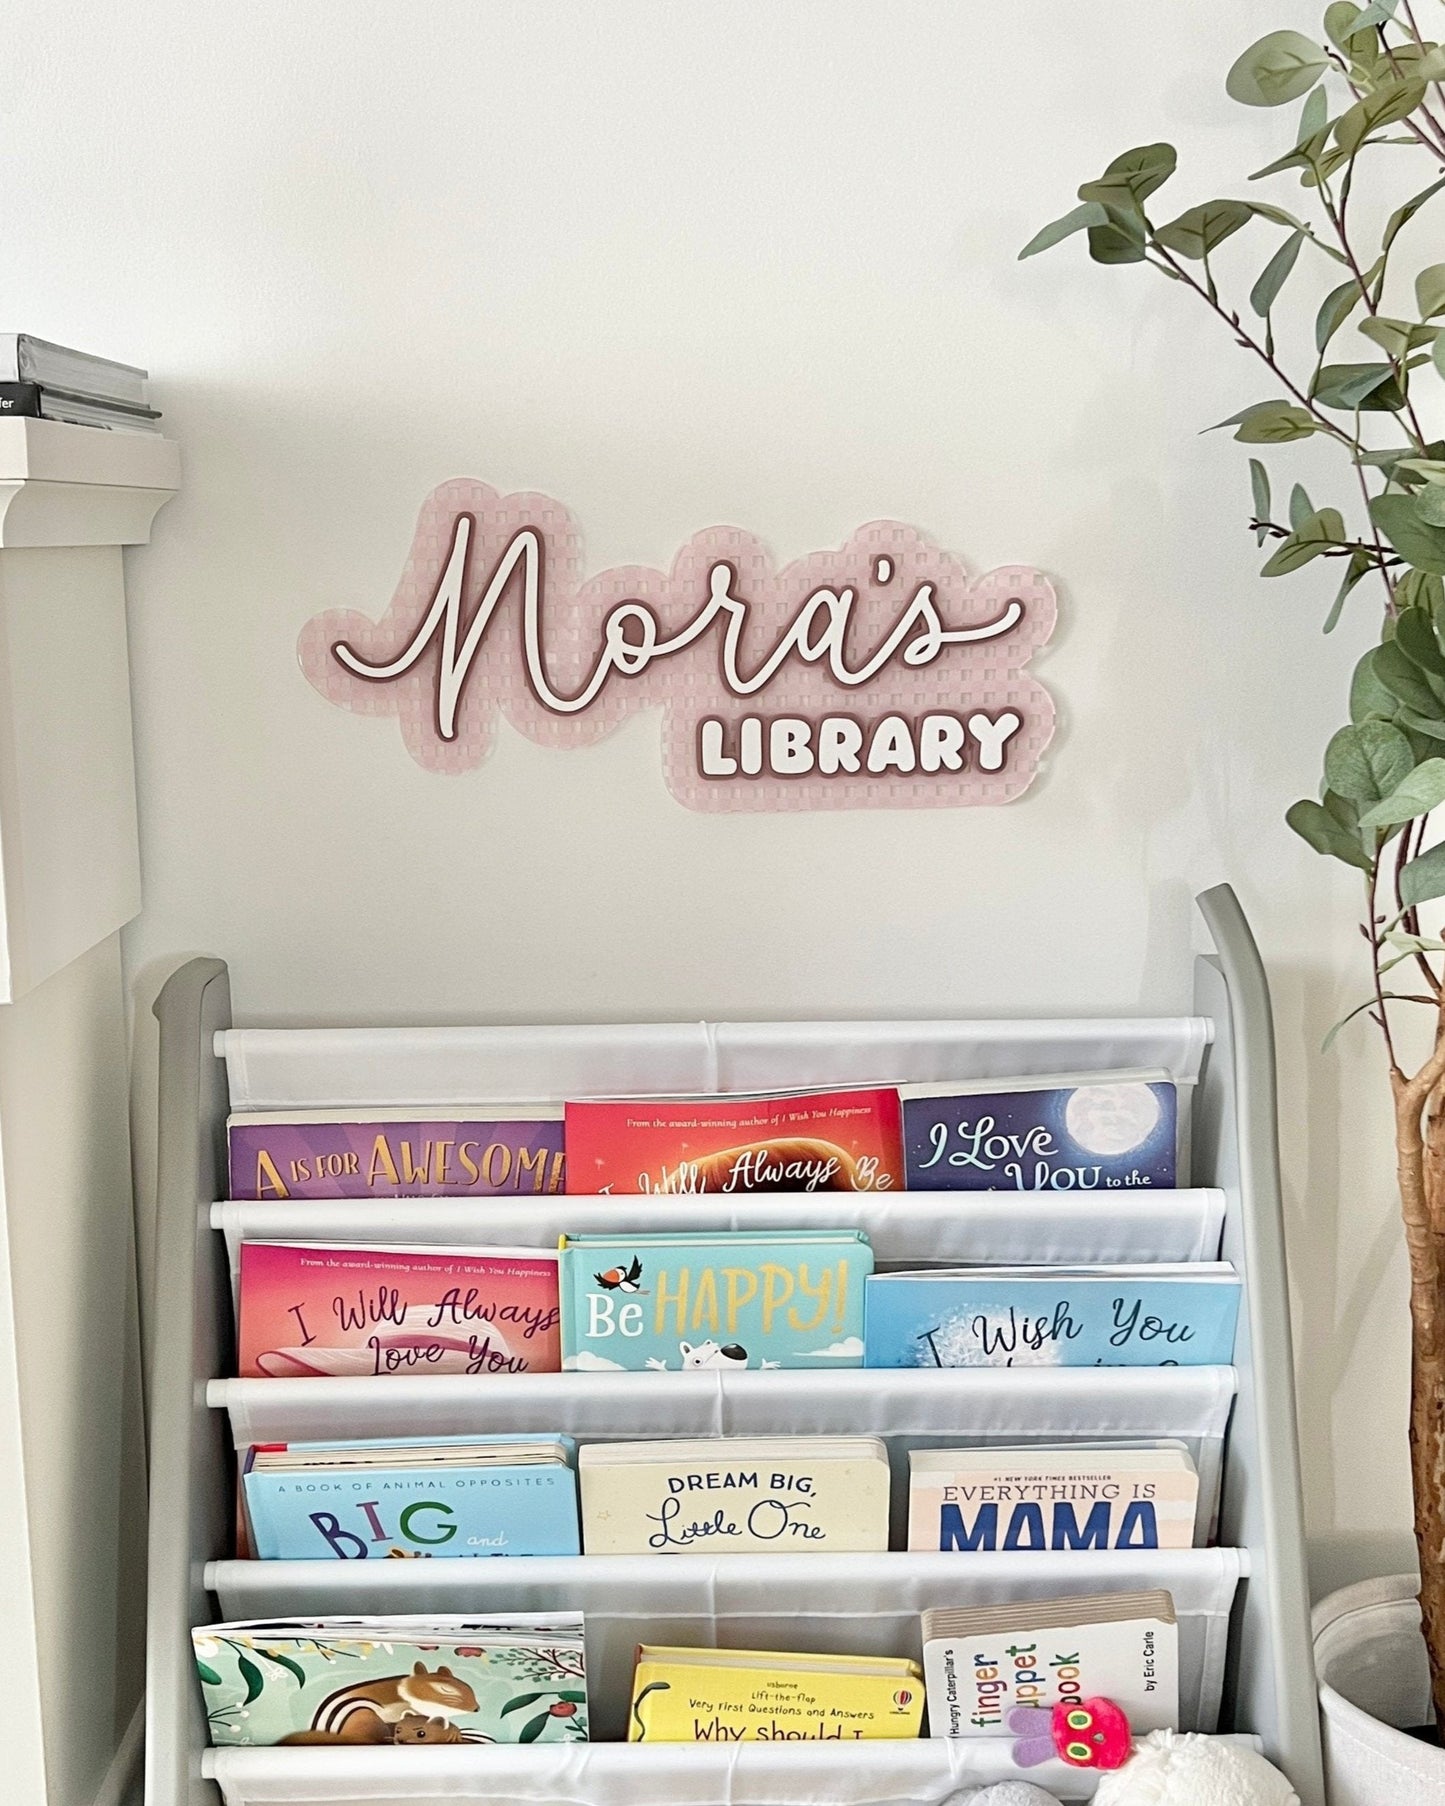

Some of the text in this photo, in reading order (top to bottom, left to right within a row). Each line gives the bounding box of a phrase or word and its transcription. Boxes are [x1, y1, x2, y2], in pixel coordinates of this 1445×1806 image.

[333, 512, 1023, 742] Nora's
[700, 712, 1022, 779] LIBRARY
[627, 1118, 650, 1127] From
[653, 1118, 666, 1127] the
[669, 1117, 737, 1129] award-winning
[739, 1115, 768, 1127] author
[770, 1114, 780, 1126] of
[789, 1110, 809, 1121] Wish
[811, 1108, 827, 1119] You
[829, 1106, 872, 1118] Happiness
[918, 1116, 1059, 1170] I Love
[256, 1150, 291, 1199] A
[290, 1158, 311, 1182] IS
[315, 1151, 360, 1178] FOR
[722, 1150, 841, 1193] Always
[849, 1156, 895, 1192] Be
[1106, 1175, 1122, 1188] to
[1125, 1170, 1152, 1187] the
[300, 1257, 323, 1267] From
[326, 1258, 340, 1267] the
[342, 1260, 411, 1272] award-winning
[412, 1263, 442, 1272] author
[444, 1263, 453, 1274] of
[464, 1265, 485, 1274] Wish
[489, 1266, 504, 1275] You
[507, 1267, 551, 1278] Happiness
[287, 1286, 560, 1347] I Will Always
[584, 1259, 849, 1338] Be HAPPY!
[971, 1300, 1084, 1355] Wish
[1109, 1297, 1196, 1346] You
[367, 1335, 529, 1376] Love You
[295, 1483, 342, 1493] BOOK
[352, 1482, 373, 1491] OF
[383, 1480, 446, 1490] ANIMAL
[456, 1477, 555, 1489] OPPOSITES
[667, 1472, 817, 1497] DREAM BIG,
[943, 1484, 1156, 1501] EVERYTHING IS
[308, 1501, 508, 1559] BIG and
[645, 1497, 826, 1548] Little One
[940, 1501, 1159, 1550] MAMA
[943, 1649, 958, 1702] Caterpillar's
[1143, 1631, 1158, 1692] by Eric Carle
[689, 1698, 714, 1713] Very
[748, 1703, 802, 1716] Questions
[806, 1709, 826, 1717] and
[830, 1708, 875, 1720] Answers
[970, 1653, 1007, 1728] finger
[694, 1717, 747, 1741] Why
[949, 1704, 961, 1735] Hungry
